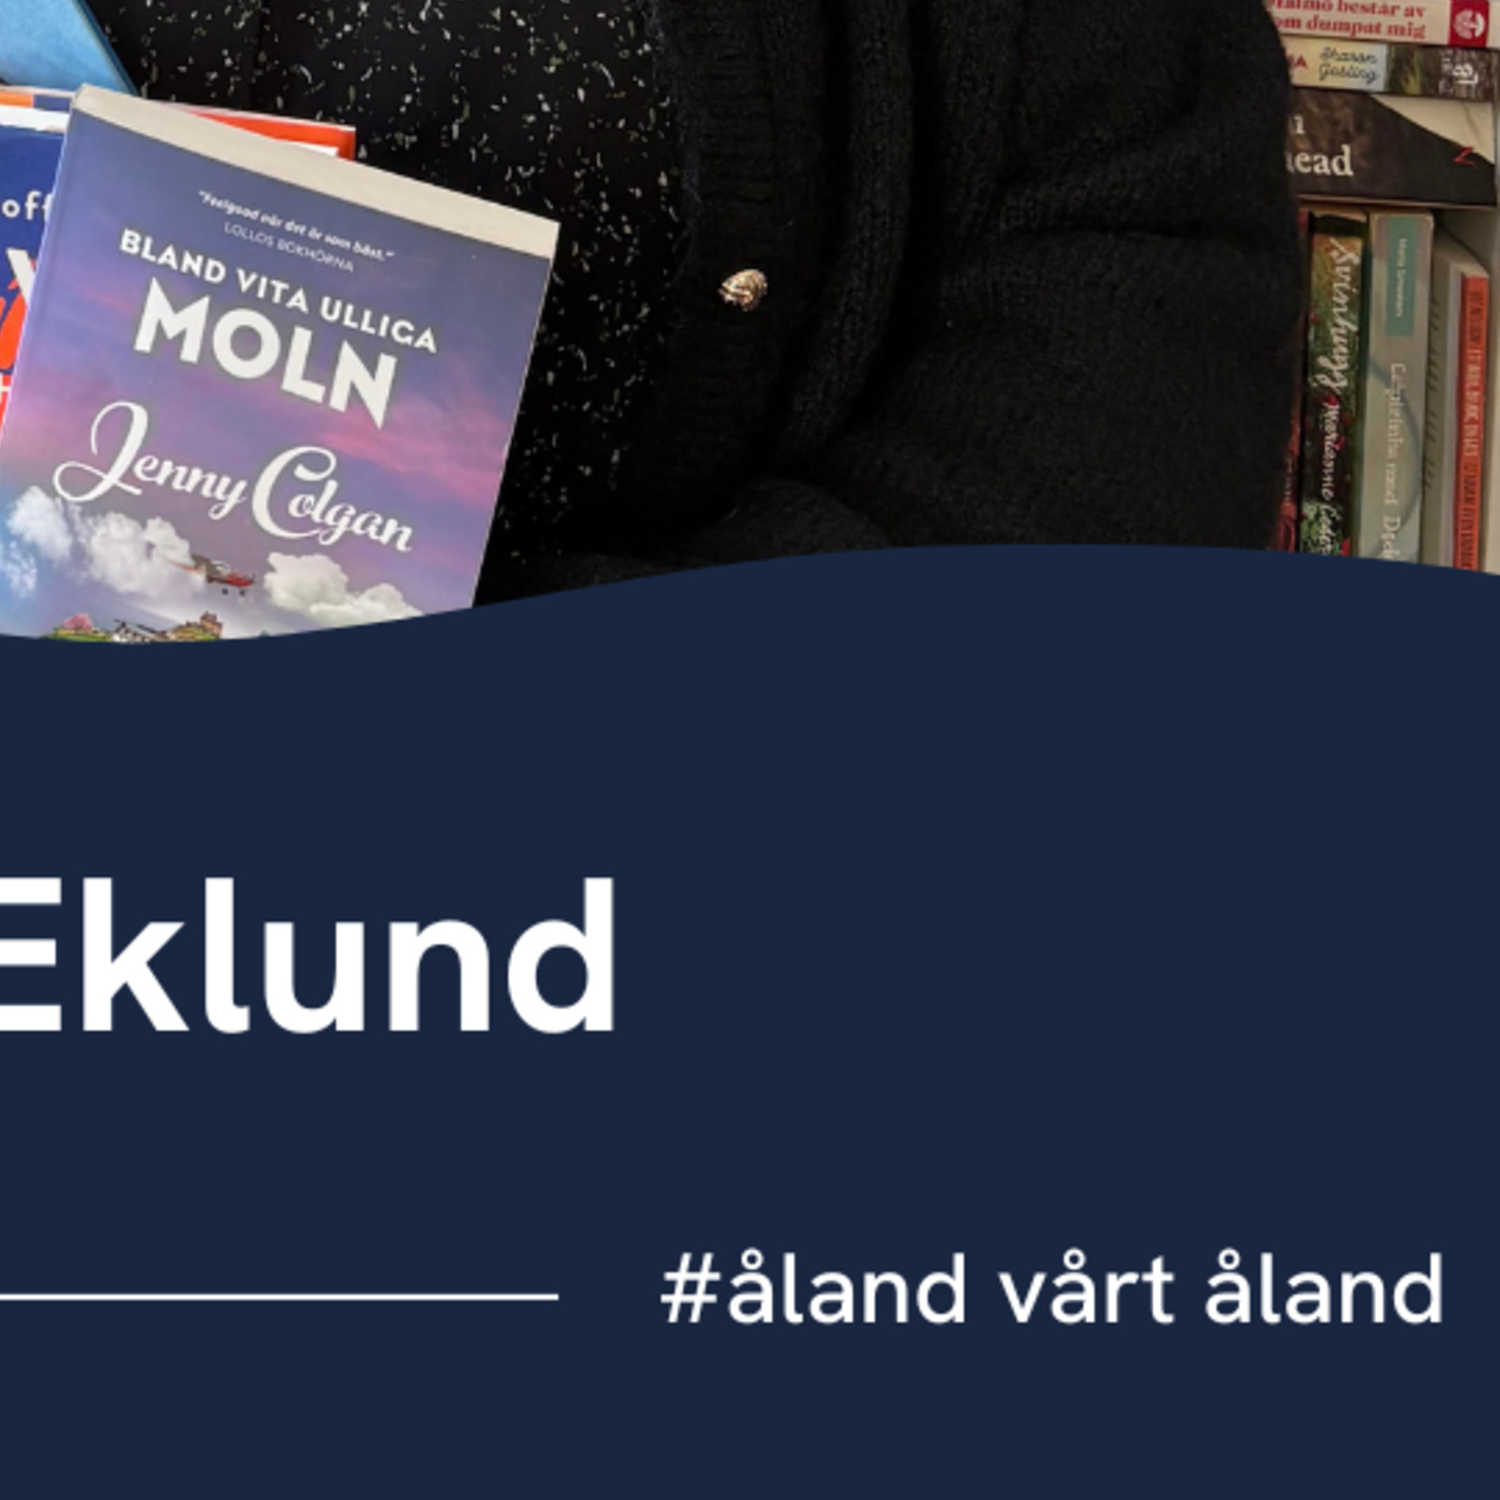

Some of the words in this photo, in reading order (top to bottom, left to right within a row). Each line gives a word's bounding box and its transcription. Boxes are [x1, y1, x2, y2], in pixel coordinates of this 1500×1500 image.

[118, 227, 226, 284] BLAND
[235, 266, 309, 314] VITA
[320, 295, 438, 354] ULLIGA
[223, 221, 275, 249] LOLLOS
[133, 275, 399, 431] MOLN
[51, 400, 247, 521] Jenny
[251, 443, 415, 554] Colgan
